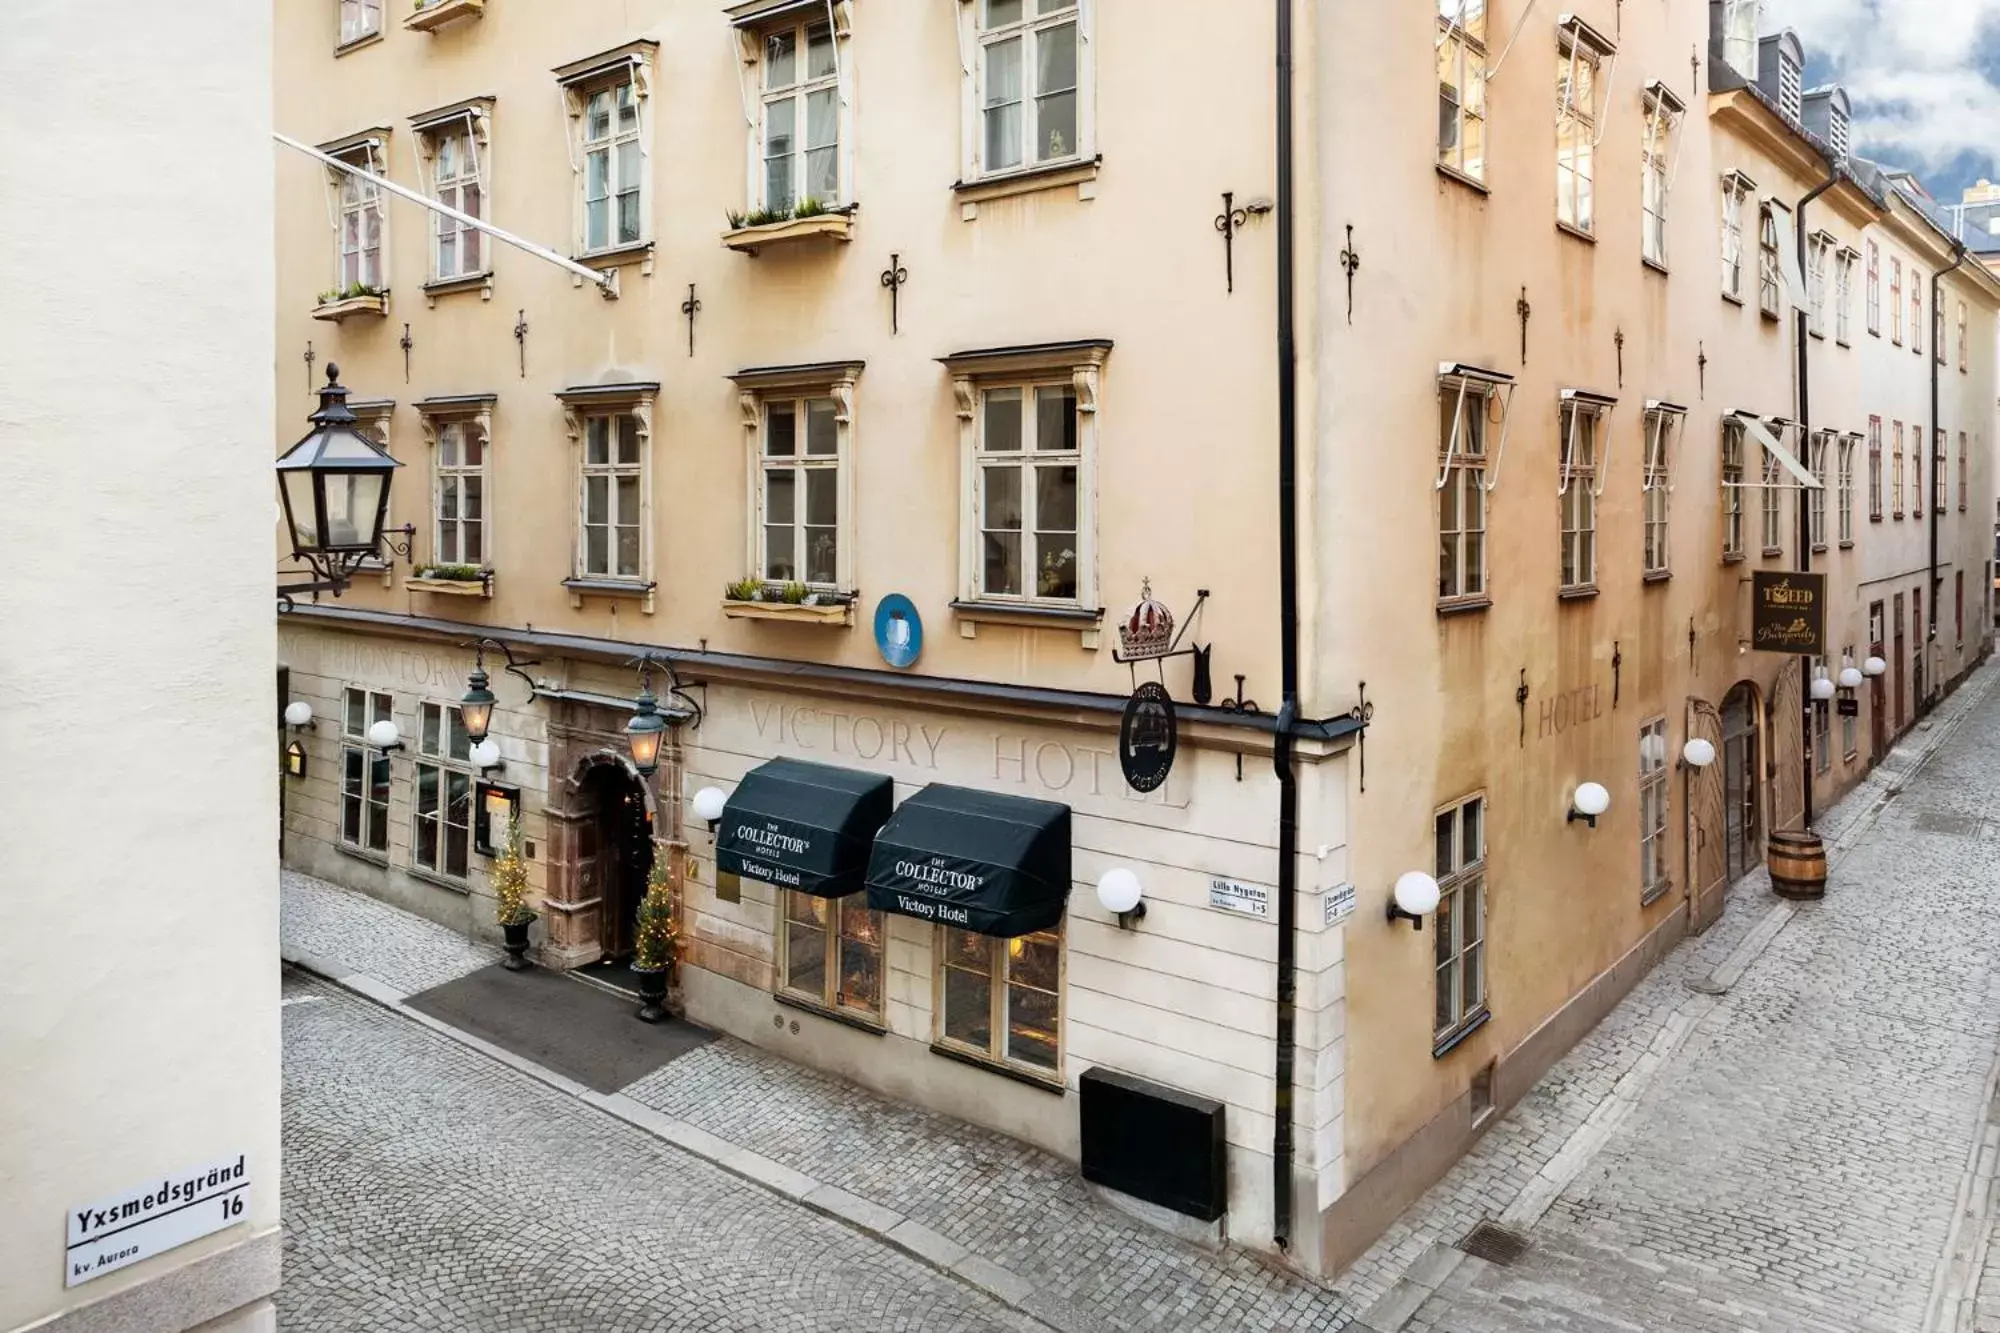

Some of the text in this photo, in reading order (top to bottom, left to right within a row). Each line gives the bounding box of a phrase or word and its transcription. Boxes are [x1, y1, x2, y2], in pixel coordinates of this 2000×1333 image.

[1538, 683, 1602, 739] HOTEL
[749, 701, 946, 769] VICTORY
[767, 822, 779, 831] THE
[755, 847, 780, 858] HOTELS
[931, 857, 945, 868] THE
[741, 859, 800, 886] Victory Hotel
[917, 883, 949, 896] HOTELS
[898, 895, 968, 924] Victory Hotel
[77, 1154, 245, 1234] Yxsmedsgränd
[222, 1194, 244, 1221] 16
[74, 1245, 140, 1276] kv. Aurora
